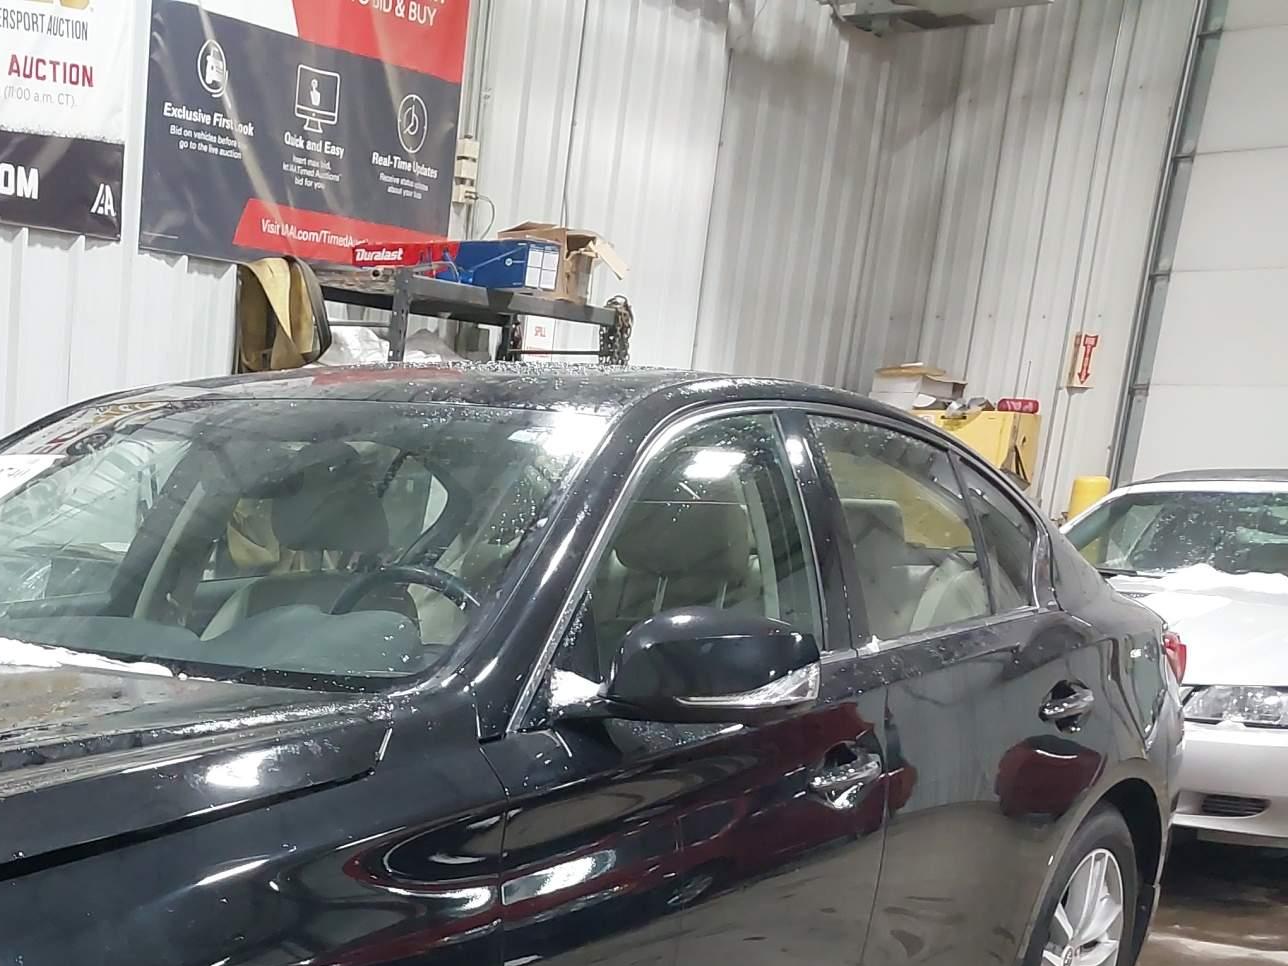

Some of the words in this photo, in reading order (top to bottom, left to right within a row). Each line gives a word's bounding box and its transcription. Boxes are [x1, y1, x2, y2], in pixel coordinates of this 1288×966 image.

[408, 1, 437, 26] BUY
[46, 15, 88, 41] AUCTION
[8, 54, 94, 87] AUCTION
[163, 102, 211, 125] Exclusive
[170, 125, 182, 135] Bid
[183, 129, 192, 137] on
[179, 140, 188, 149] go
[190, 141, 196, 150] to
[198, 143, 207, 152] the
[284, 131, 304, 149] Quick
[306, 140, 322, 153] and
[324, 141, 344, 160] Easy
[372, 152, 412, 172] Real-Time
[412, 161, 438, 179] Updates
[261, 218, 280, 234] Visit
[355, 248, 403, 261] Duralast
